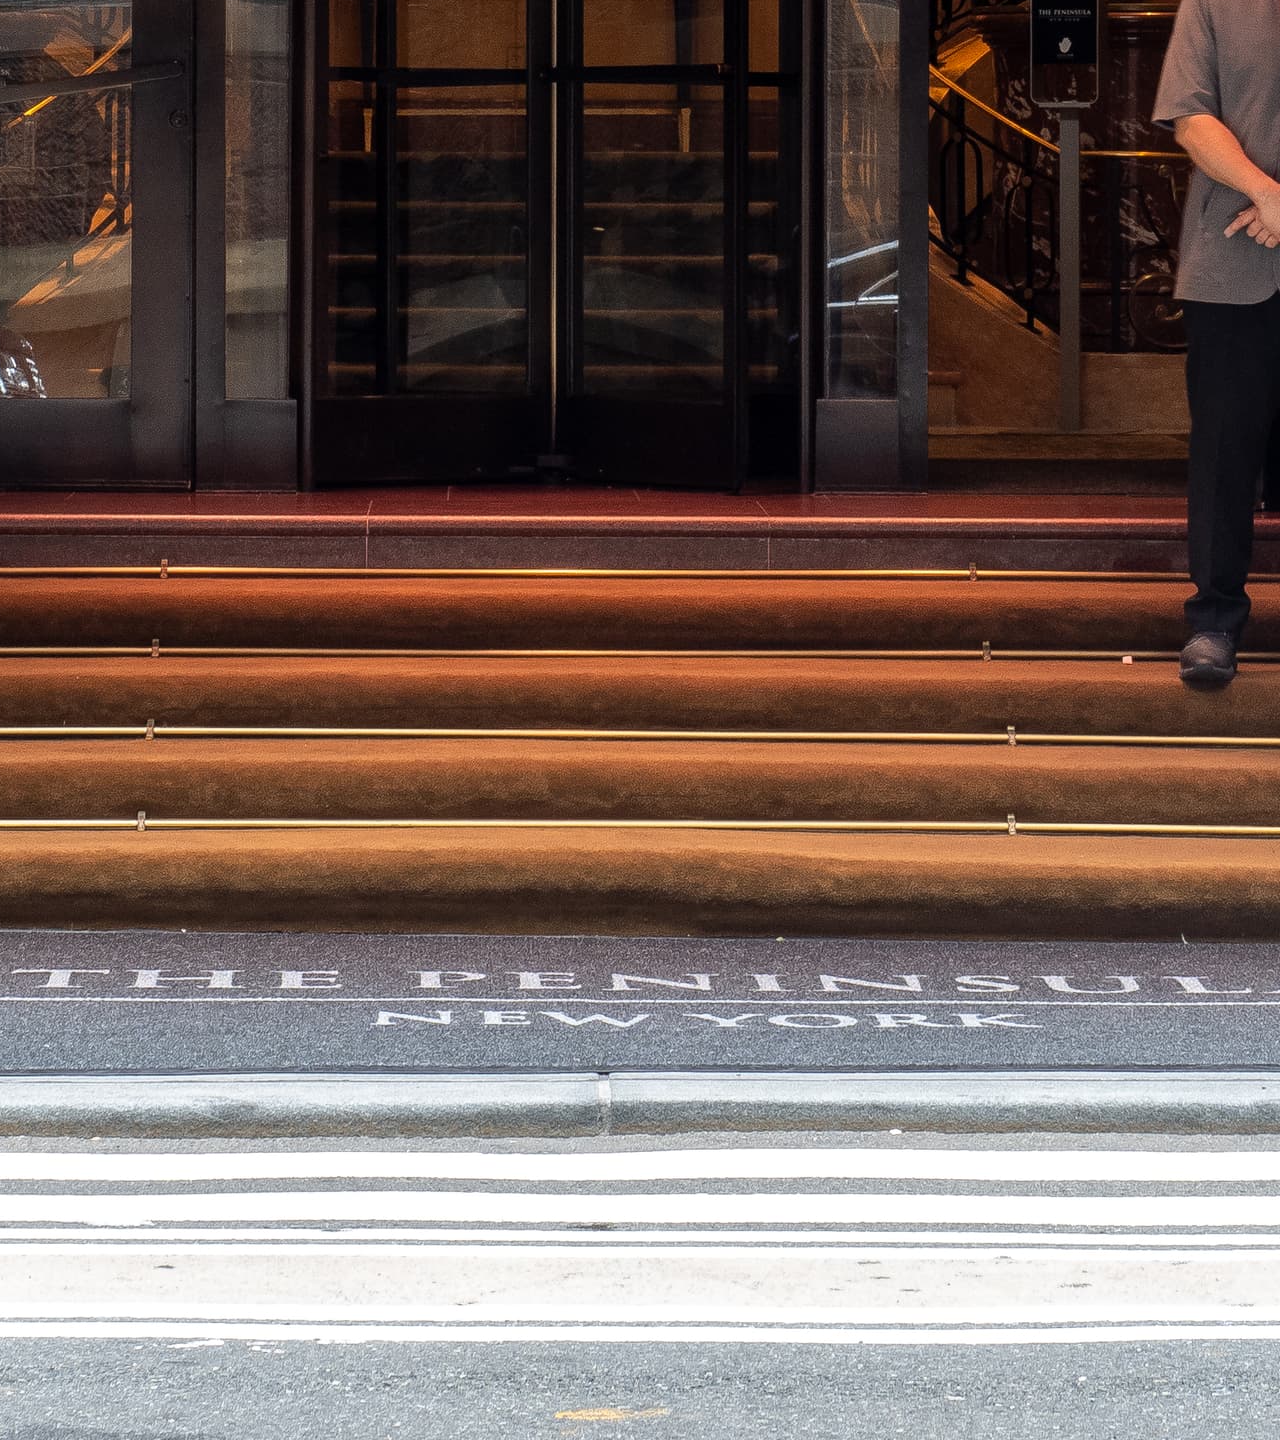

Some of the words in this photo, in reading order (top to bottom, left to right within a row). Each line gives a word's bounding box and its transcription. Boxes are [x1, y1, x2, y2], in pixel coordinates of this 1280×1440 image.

[11, 968, 343, 990] THE
[371, 1010, 651, 1028] NEW
[682, 1012, 1044, 1030] YORK
